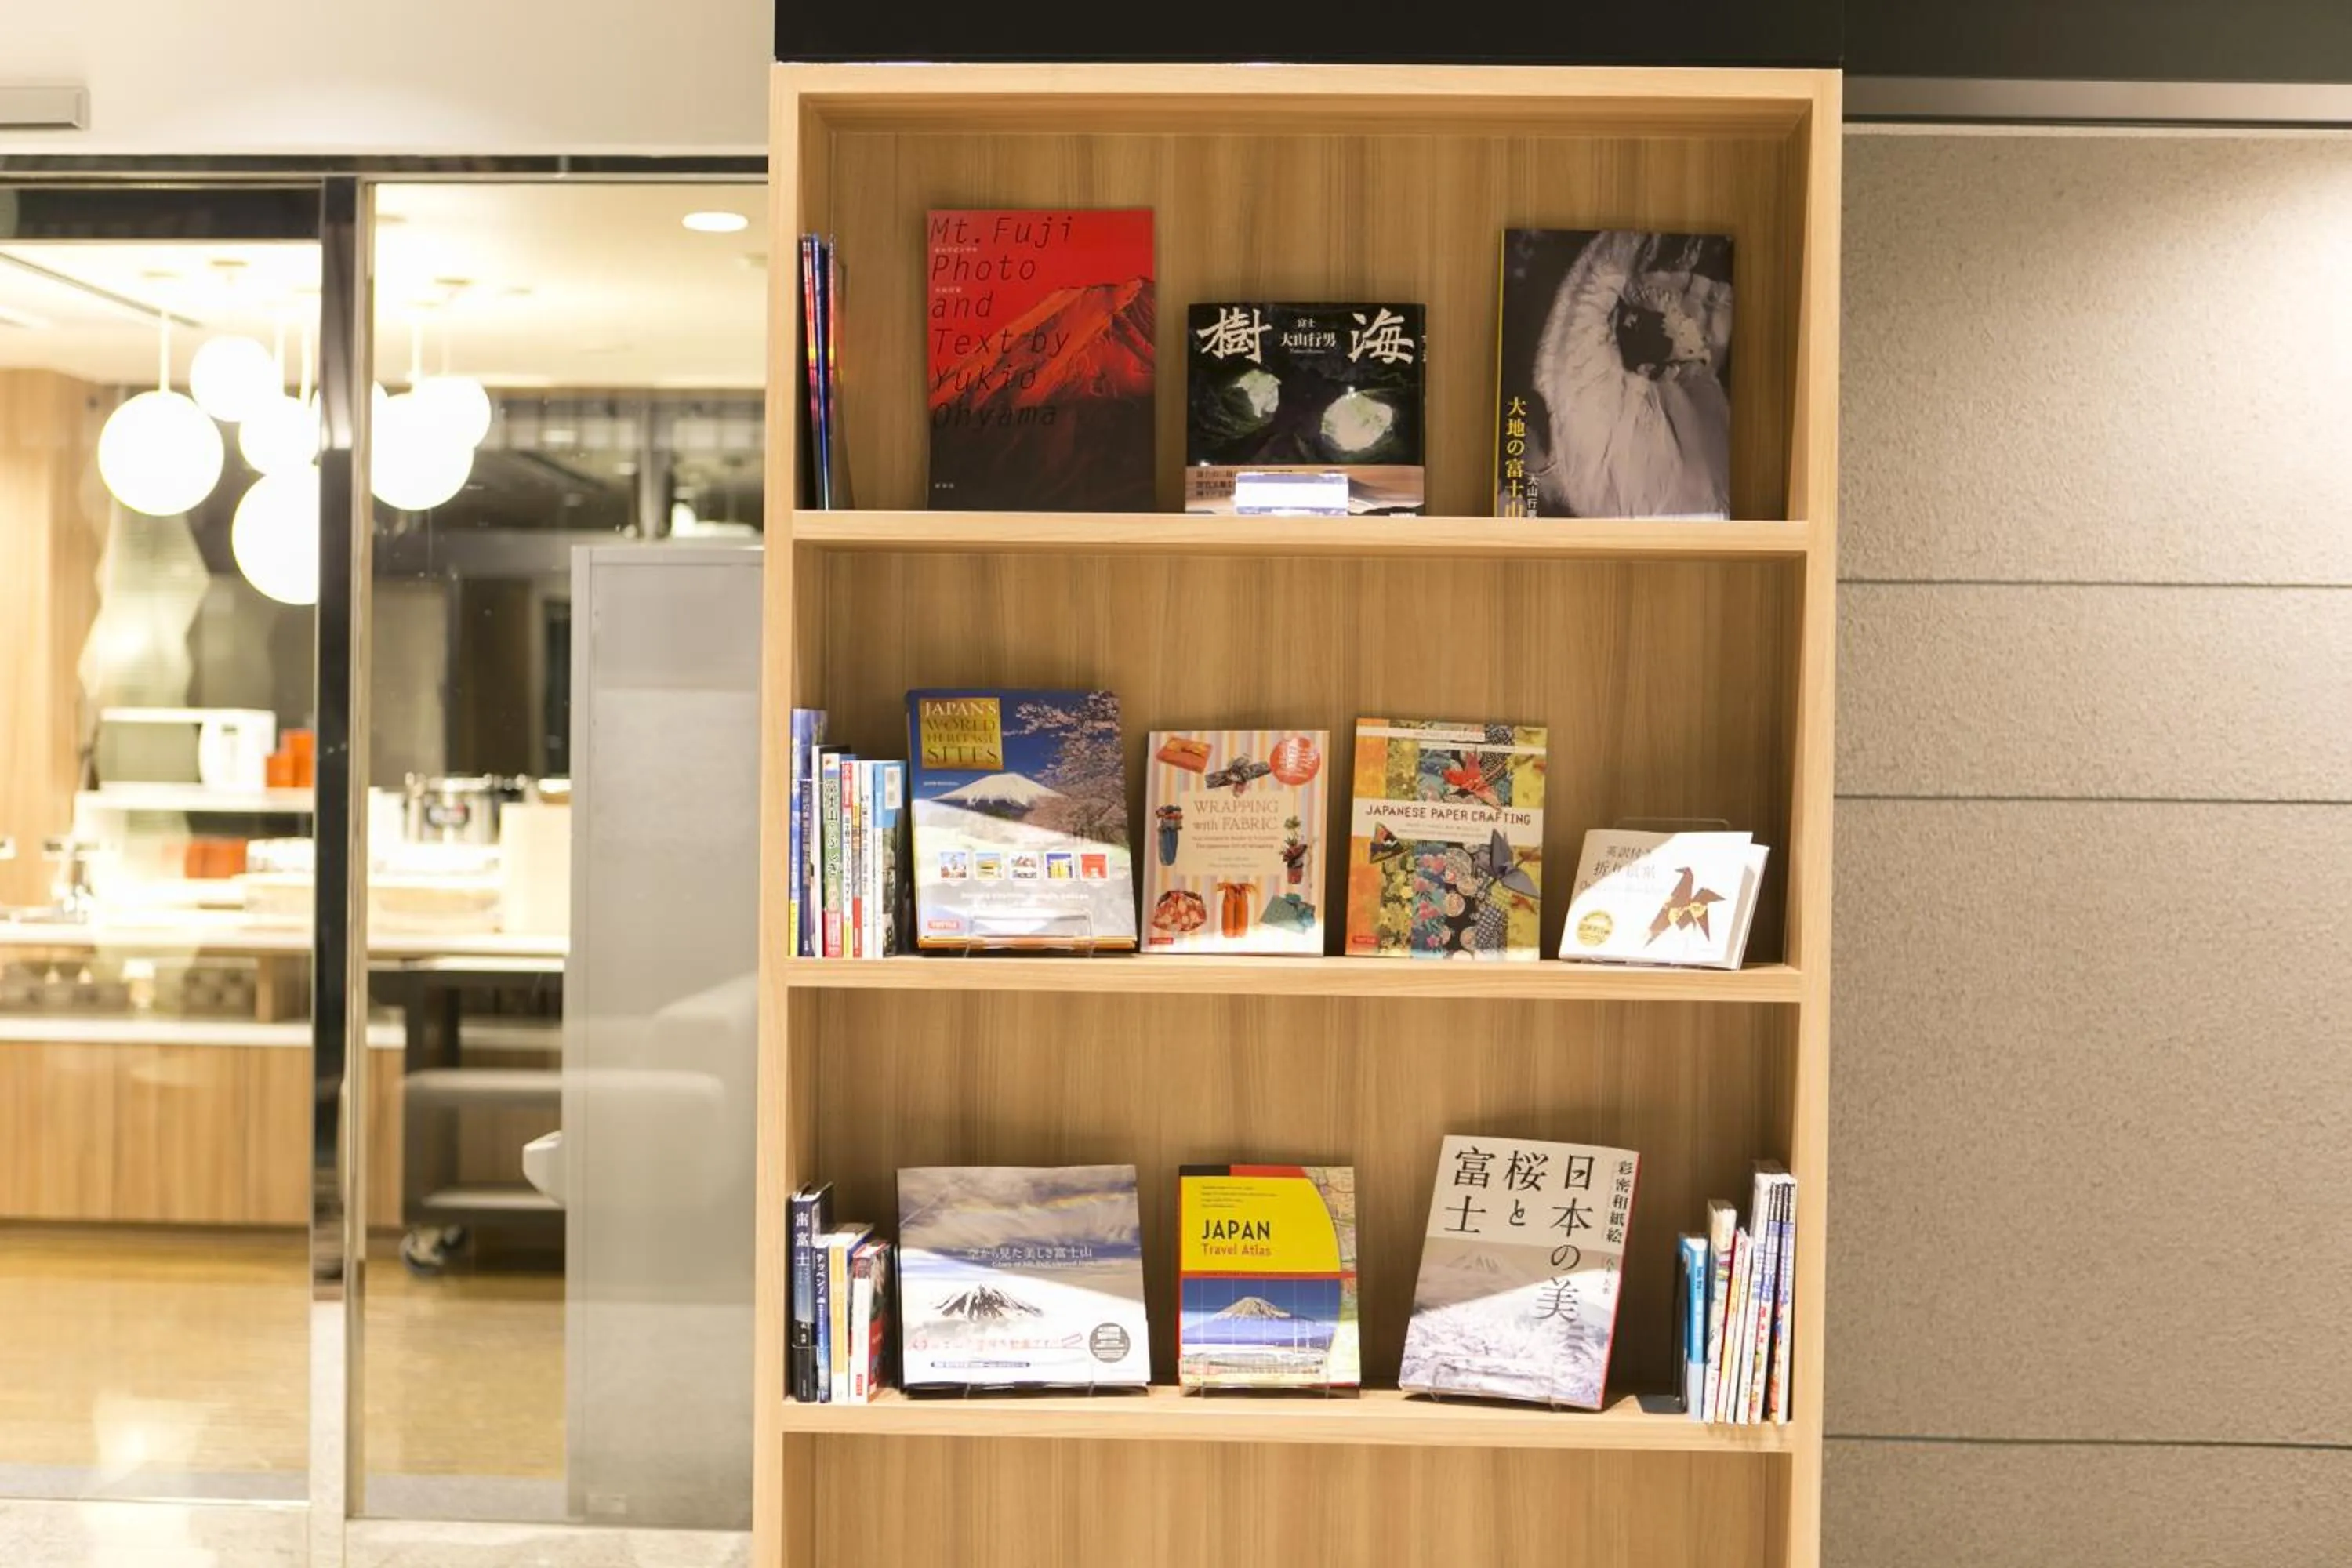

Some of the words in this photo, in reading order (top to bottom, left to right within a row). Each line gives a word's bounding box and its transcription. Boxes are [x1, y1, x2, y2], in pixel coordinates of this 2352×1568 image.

[930, 217, 981, 244] Mt.
[993, 216, 1073, 249] Fuji
[932, 254, 1036, 281] Photo
[931, 290, 993, 318] and
[935, 328, 1014, 356] Text
[1030, 326, 1070, 357] by
[1196, 307, 1273, 364] 樹
[1346, 307, 1414, 364] 海
[1279, 332, 1337, 347] 大山行男
[935, 365, 1037, 392] Yukio
[931, 401, 1058, 431] Ohyama
[1504, 396, 1526, 517] 大地の富士山
[1194, 800, 1279, 814] WRAPPING
[1365, 804, 1426, 818] JAPANESE
[1431, 808, 1468, 822] PAPER
[1472, 811, 1531, 826] CRAFTING
[1221, 816, 1278, 830] FABRIC
[1444, 1145, 1496, 1233] 富士
[1504, 1150, 1549, 1227] 桜と
[1201, 1219, 1271, 1240] JAPAN
[1535, 1154, 1595, 1323] 日本の美
[1201, 1243, 1237, 1256] Travel
[1241, 1243, 1272, 1256] Atlas
